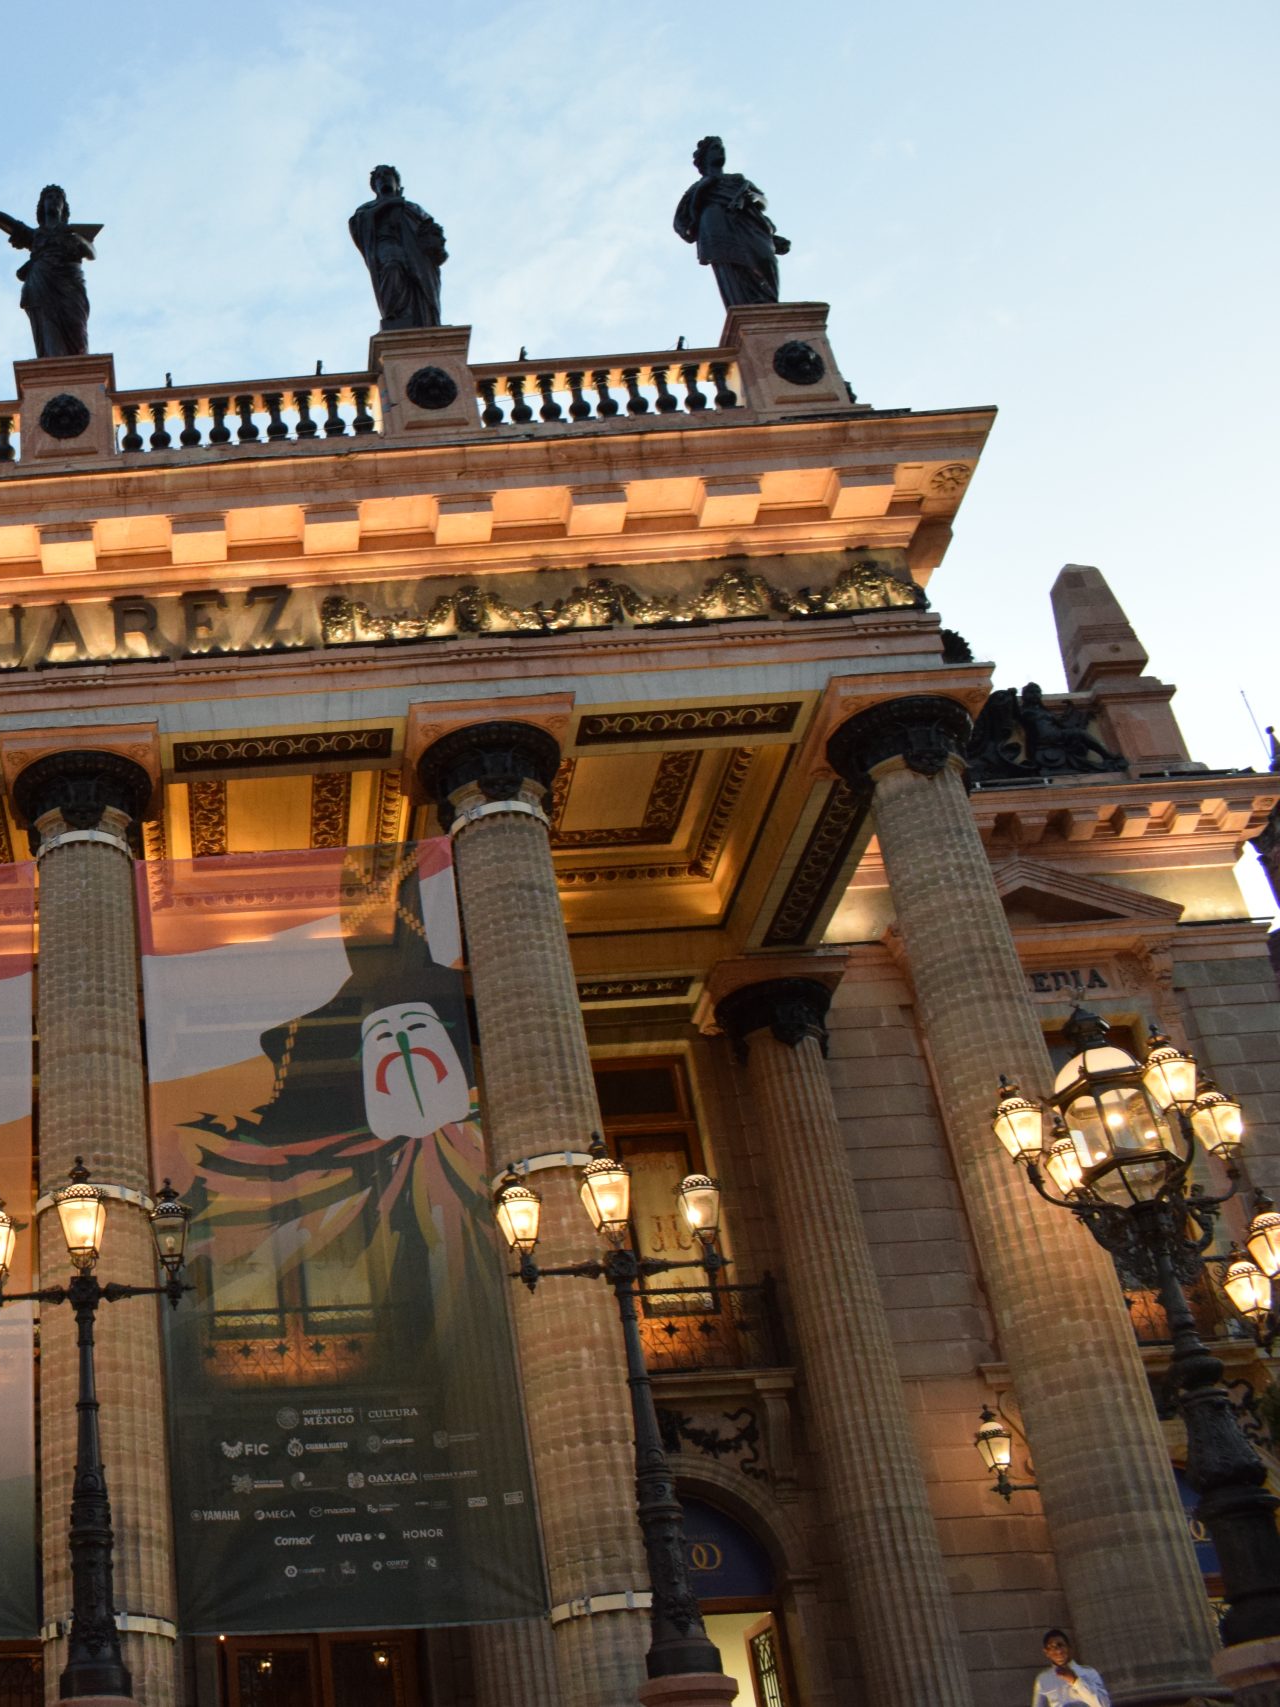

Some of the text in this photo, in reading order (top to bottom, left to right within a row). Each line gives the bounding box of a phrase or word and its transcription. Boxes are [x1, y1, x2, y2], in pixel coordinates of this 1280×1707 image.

[1028, 968, 1108, 993] EDIA
[368, 1407, 419, 1418] CULTURA
[303, 1414, 355, 1426] MÉXICO
[244, 1443, 269, 1456] FIC
[367, 1472, 418, 1483] OAXACA
[201, 1509, 241, 1521] YAMAHA
[275, 1534, 315, 1546] Comex
[402, 1529, 444, 1539] HONOR
